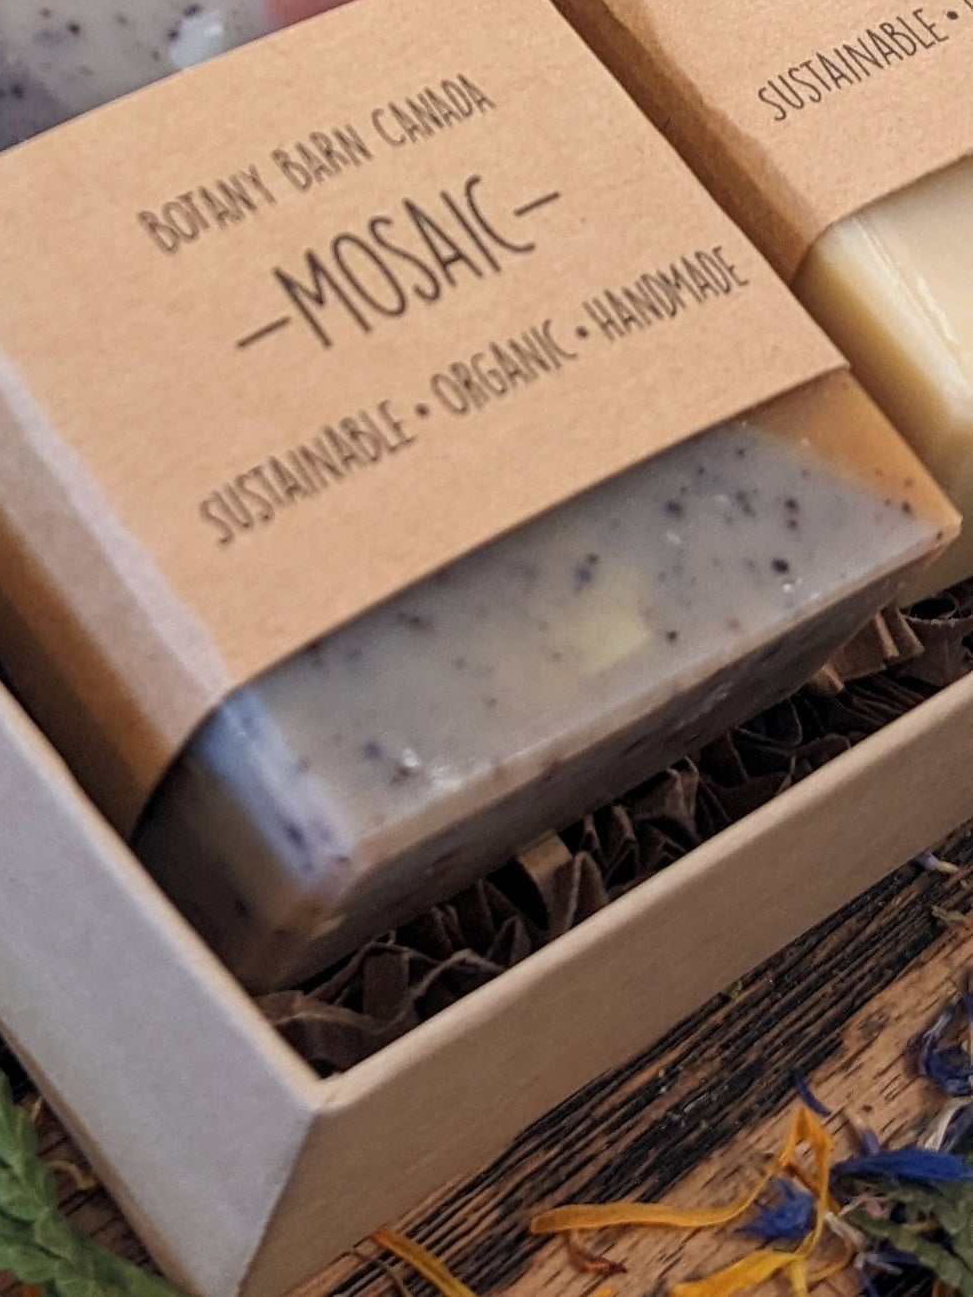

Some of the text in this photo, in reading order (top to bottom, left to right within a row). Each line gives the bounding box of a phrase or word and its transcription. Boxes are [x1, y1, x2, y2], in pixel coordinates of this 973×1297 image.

[758, 8, 949, 121] SUSTAINABLE
[137, 74, 496, 254] BOTANY BARN CANADA
[199, 246, 749, 546] SUSTAINABLE ORGANIC HANDMADE
